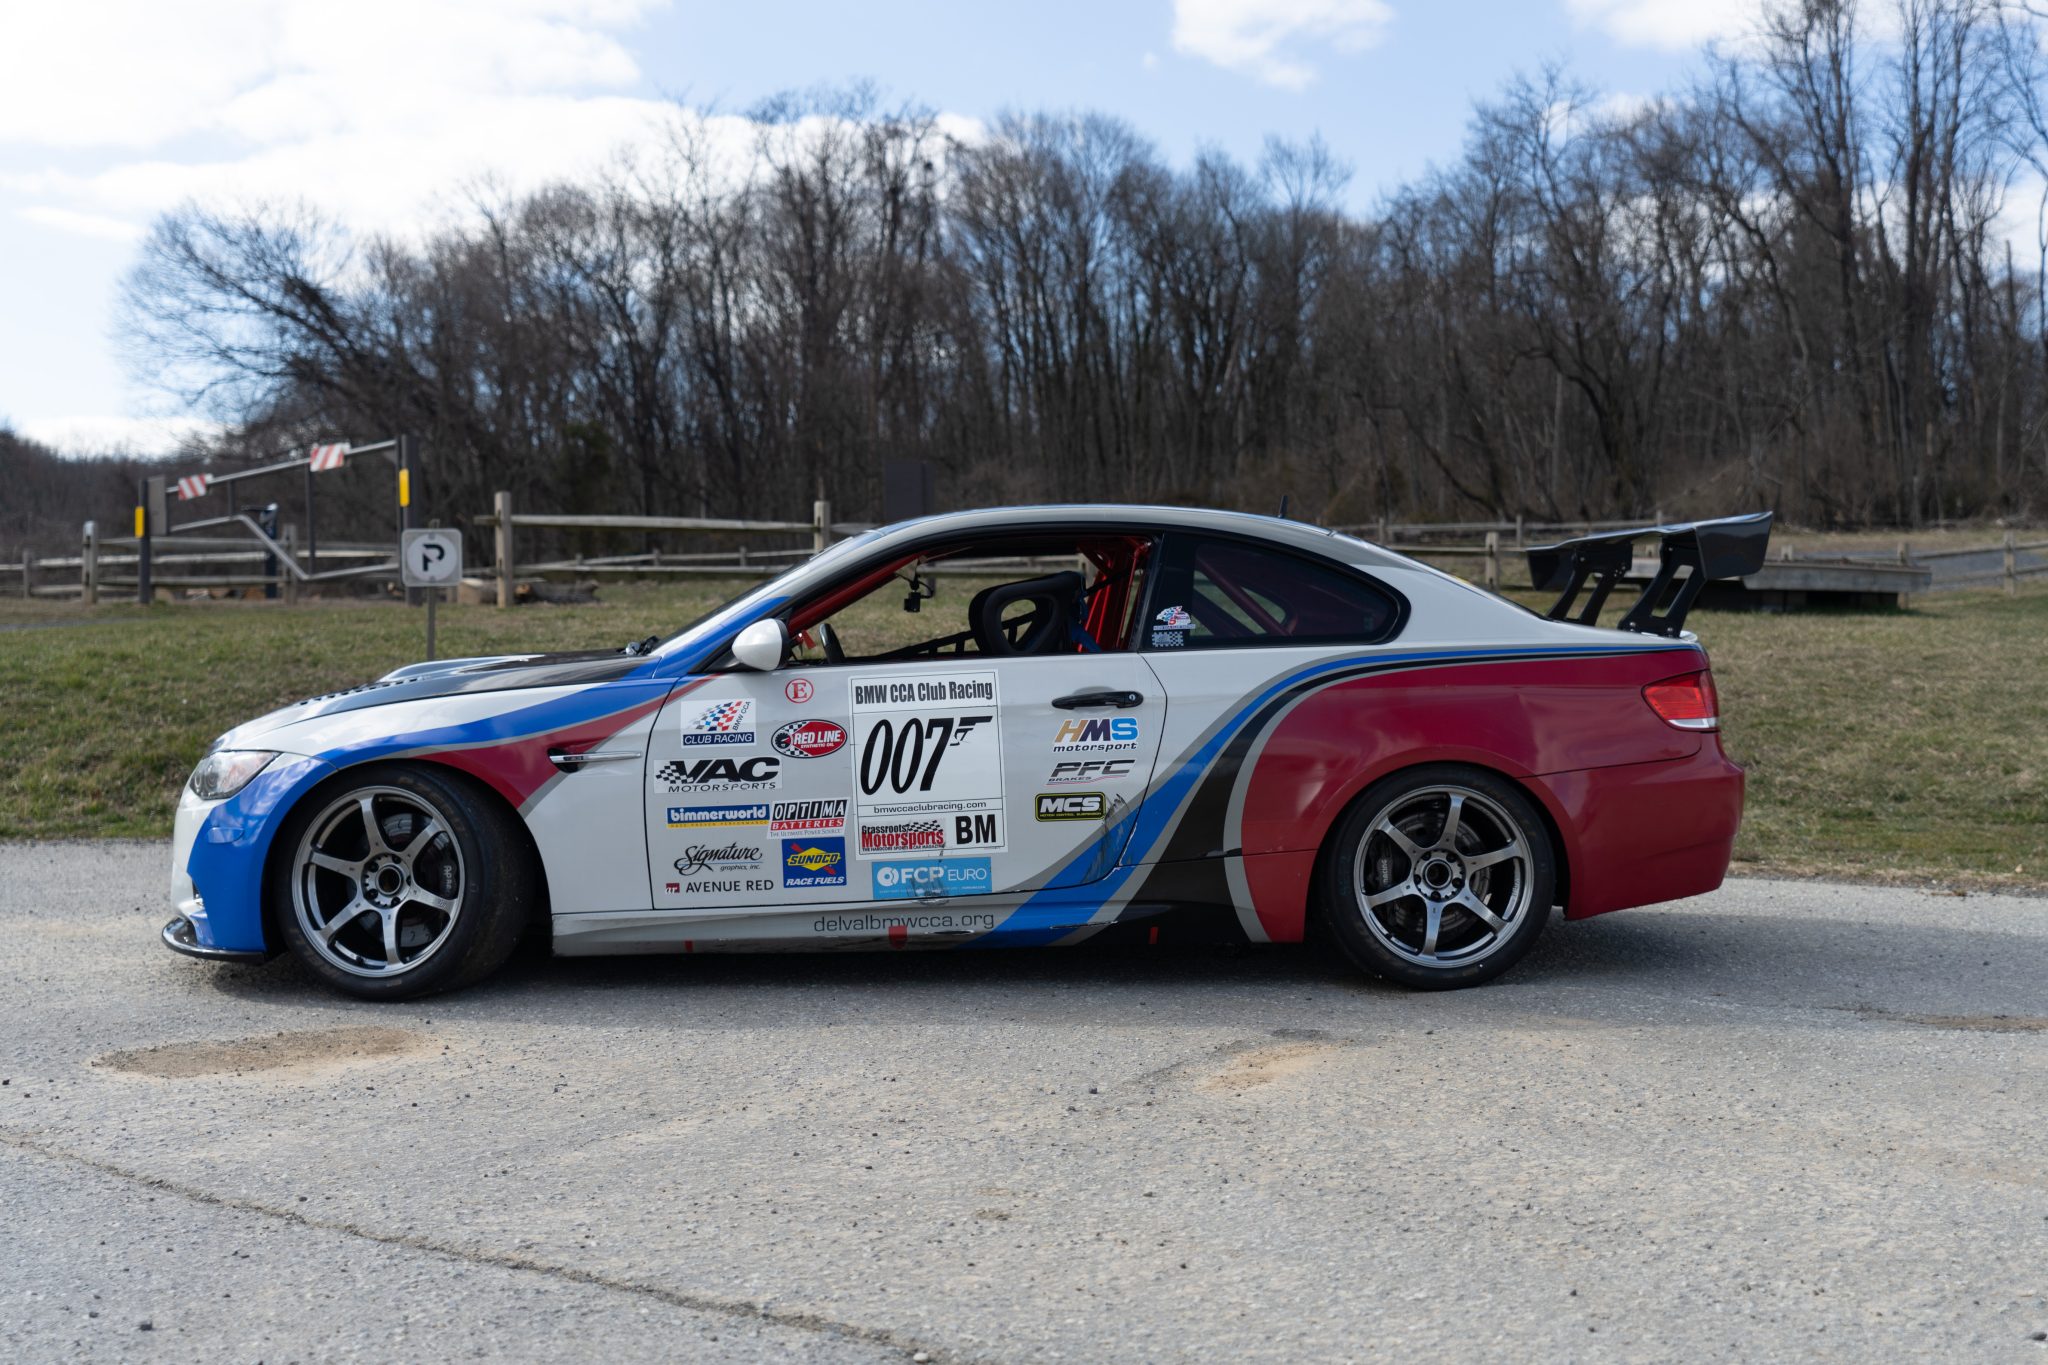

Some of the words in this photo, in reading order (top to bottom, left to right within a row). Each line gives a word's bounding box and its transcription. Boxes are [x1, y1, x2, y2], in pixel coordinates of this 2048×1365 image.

[792, 682, 808, 699] E
[855, 684, 888, 704] BMW
[890, 683, 915, 702] CCA
[917, 682, 946, 701] Club
[949, 680, 993, 700] Racing
[732, 714, 744, 730] BMW
[741, 701, 751, 714] CCA
[794, 731, 815, 745] RED
[817, 730, 842, 743] LINE
[1054, 717, 1139, 743] HMS
[684, 734, 712, 745] CLUB
[713, 733, 753, 745] RACING
[1053, 742, 1137, 752] motorsport
[860, 717, 954, 796] 007
[670, 757, 780, 784] VAC
[1050, 760, 1135, 777] PFC
[668, 782, 776, 793] MOTORSPORTS
[774, 800, 847, 820] OPTIMA
[873, 801, 987, 814] bmwccaclubracing.com
[1040, 796, 1101, 813] MCS
[670, 806, 767, 822] bimmerworld
[772, 818, 844, 830] BATTERIES
[861, 824, 908, 835] Grassroots
[955, 814, 997, 845] BM
[861, 830, 944, 850] Motorsports
[674, 842, 764, 876] Signature
[789, 853, 838, 865] SUNOCO
[720, 864, 748, 873] graphics,
[901, 866, 945, 884] FCP
[947, 867, 987, 881] EURO
[685, 881, 741, 893] AVENUE
[746, 879, 774, 891] RED
[786, 878, 813, 886] RACE
[814, 876, 845, 885] FUELS
[814, 914, 995, 932] delvalbmwcca.org
